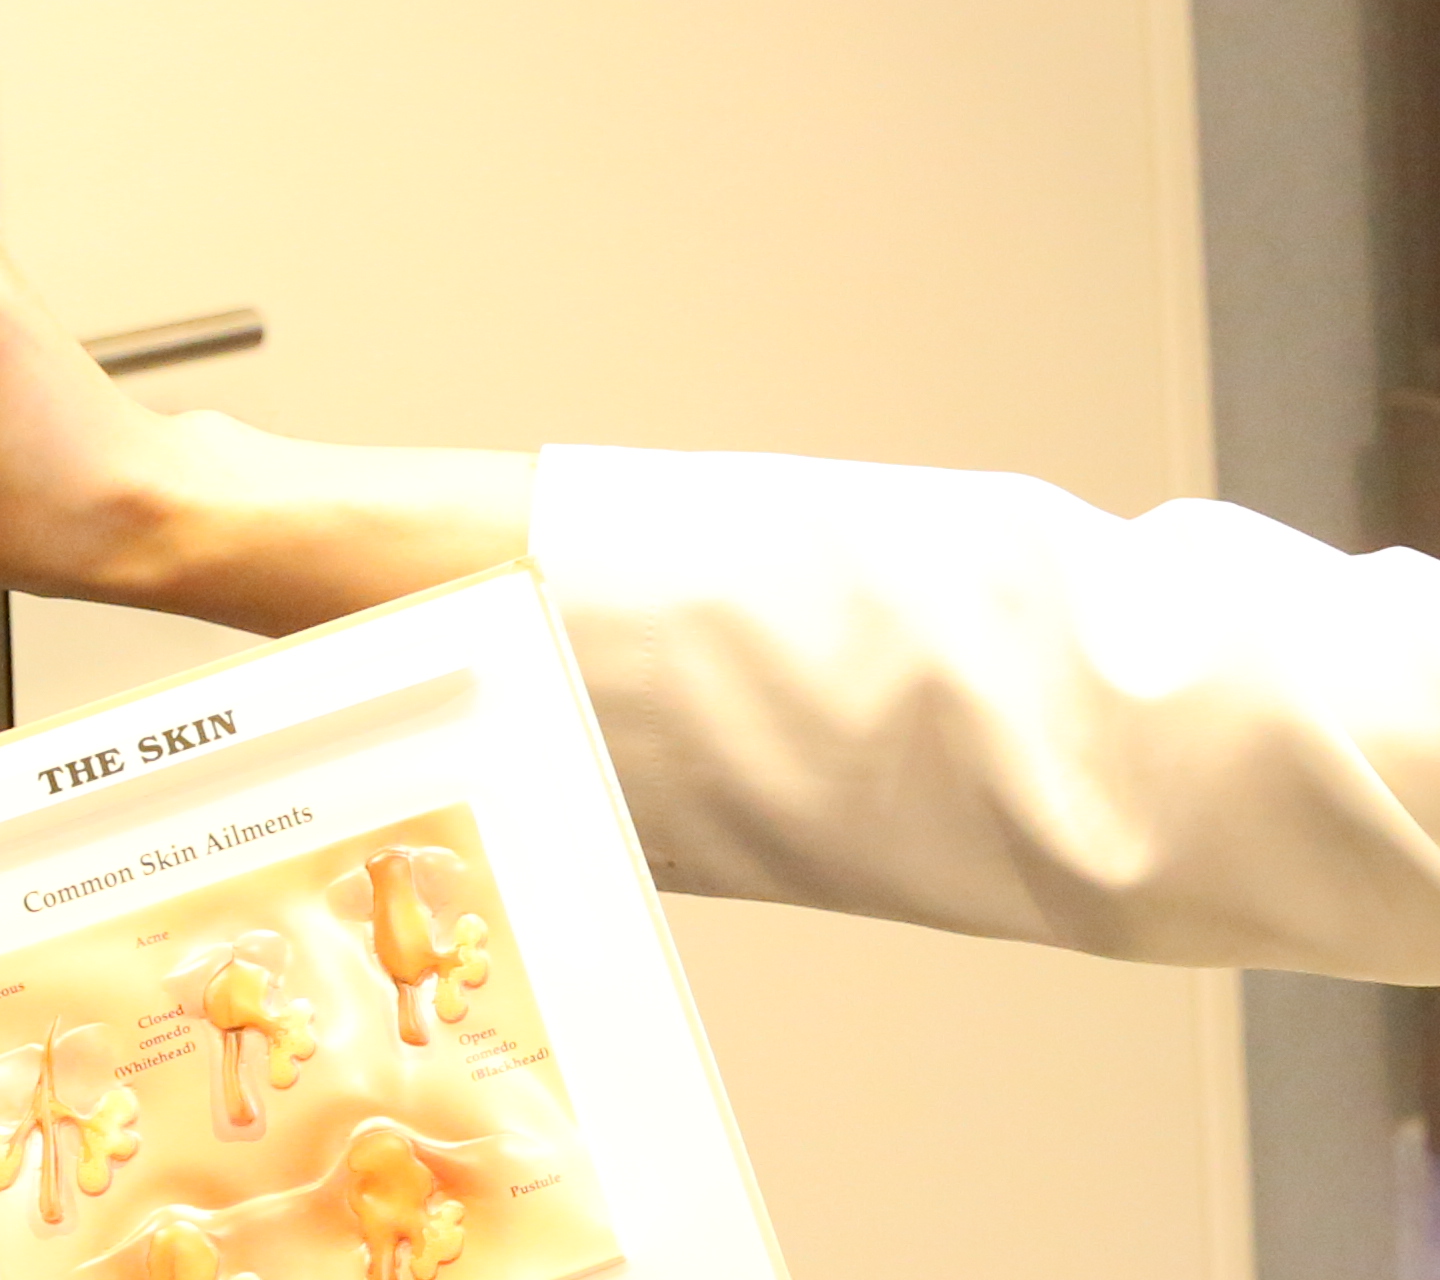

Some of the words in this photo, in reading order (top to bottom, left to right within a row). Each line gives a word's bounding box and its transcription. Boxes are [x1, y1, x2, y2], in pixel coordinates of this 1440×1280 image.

[37, 747, 126, 796] THE
[138, 709, 239, 764] SKIN
[22, 863, 136, 913] Common
[140, 844, 197, 878] Skin
[205, 804, 314, 855] Ailments
[135, 929, 170, 949] Acne
[137, 1003, 186, 1030] Closed
[138, 1022, 191, 1051] comedo
[458, 1024, 497, 1050] Open
[465, 1036, 518, 1064] comedo
[114, 1040, 197, 1081] (Whitehead)
[470, 1046, 550, 1082] (Blackhead)
[509, 1172, 562, 1199] Pustule
